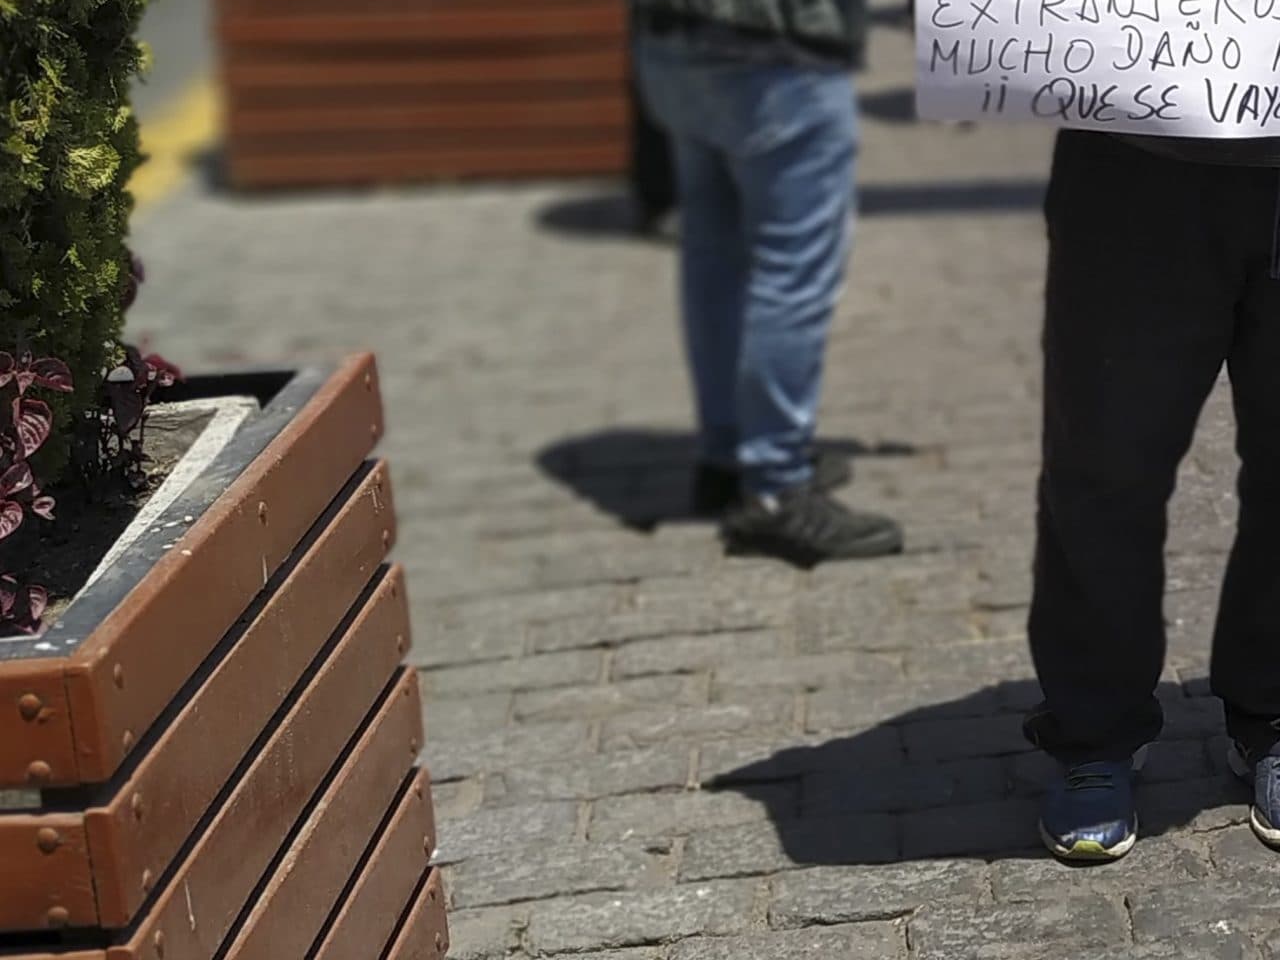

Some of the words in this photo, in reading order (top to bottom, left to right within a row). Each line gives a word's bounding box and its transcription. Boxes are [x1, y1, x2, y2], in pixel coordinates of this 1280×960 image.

[931, 36, 1094, 76] MUCHO
[1111, 20, 1243, 72] DAÑO
[1031, 78, 1118, 123] QUE
[1127, 82, 1184, 123] SE
